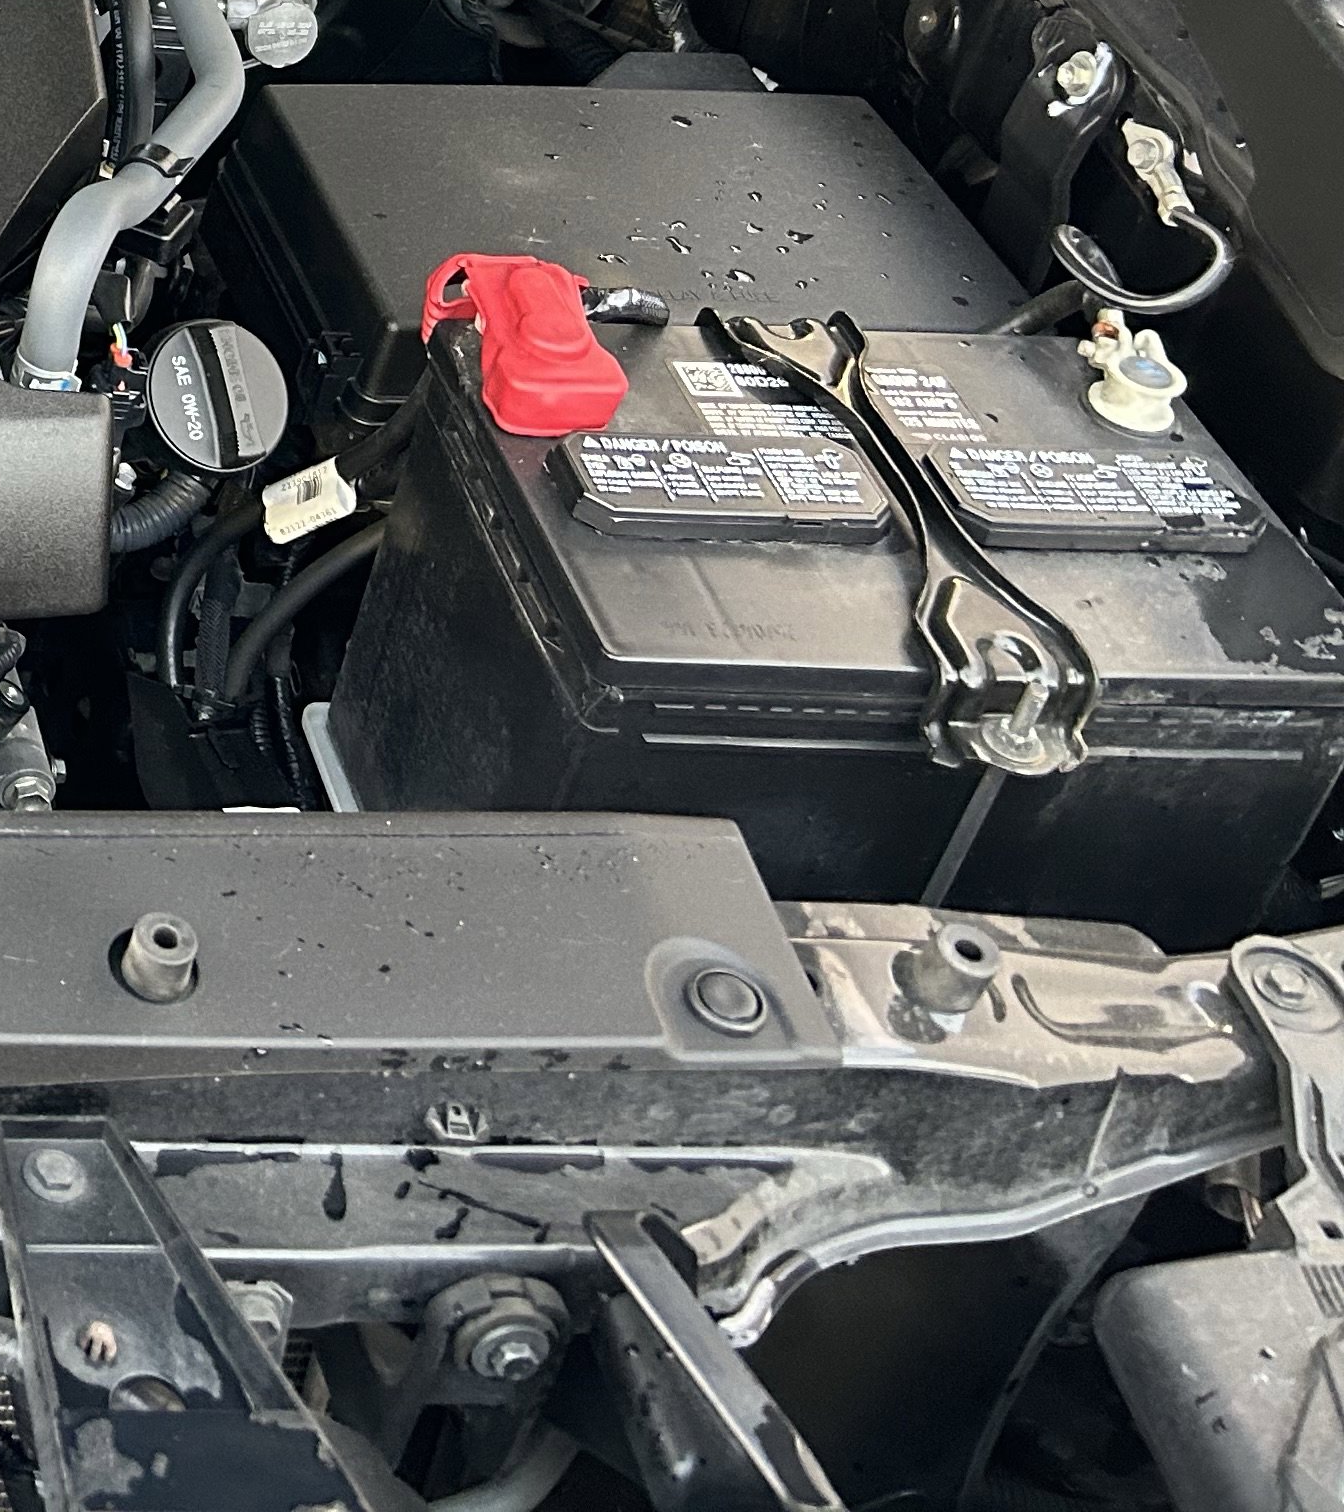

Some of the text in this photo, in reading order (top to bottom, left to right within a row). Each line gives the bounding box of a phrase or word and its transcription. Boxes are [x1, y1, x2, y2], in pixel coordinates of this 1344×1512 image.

[172, 356, 204, 440] SAE 0W-20
[599, 437, 660, 452] DANGER
[670, 439, 728, 453] POISON
[965, 448, 1028, 463] DANGER
[1038, 450, 1096, 464] POISON
